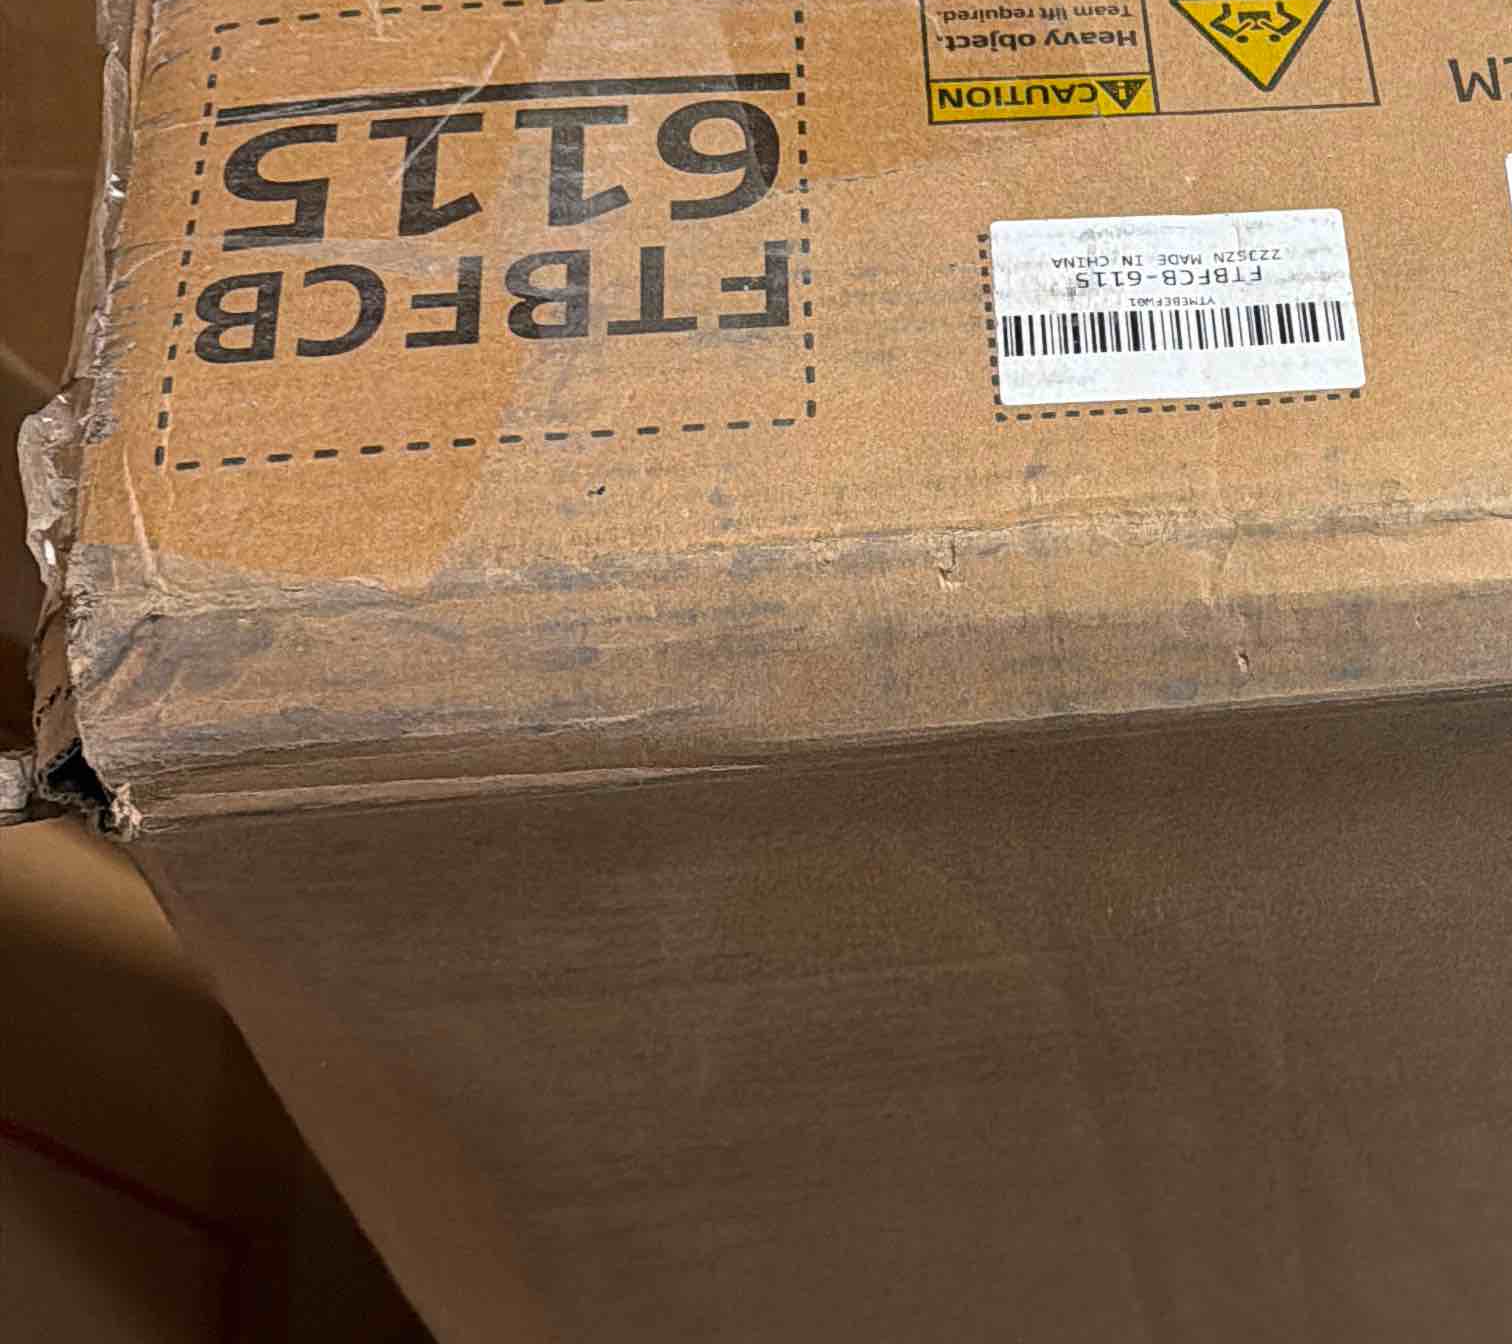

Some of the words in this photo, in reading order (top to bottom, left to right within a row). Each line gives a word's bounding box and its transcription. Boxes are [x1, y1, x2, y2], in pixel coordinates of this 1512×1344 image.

[935, 6, 1036, 24] required.
[1039, 7, 1068, 22] lift
[1072, 4, 1132, 18] Team
[1044, 30, 1138, 49] Heavy
[937, 81, 1099, 109] CAUTION
[221, 99, 782, 253] 6115
[1050, 254, 1110, 270] CHINA
[1121, 254, 1143, 268] IN
[1156, 252, 1202, 267] MADE
[1075, 265, 1262, 290] FTBFCB-6115
[193, 240, 793, 365] FTBFCB
